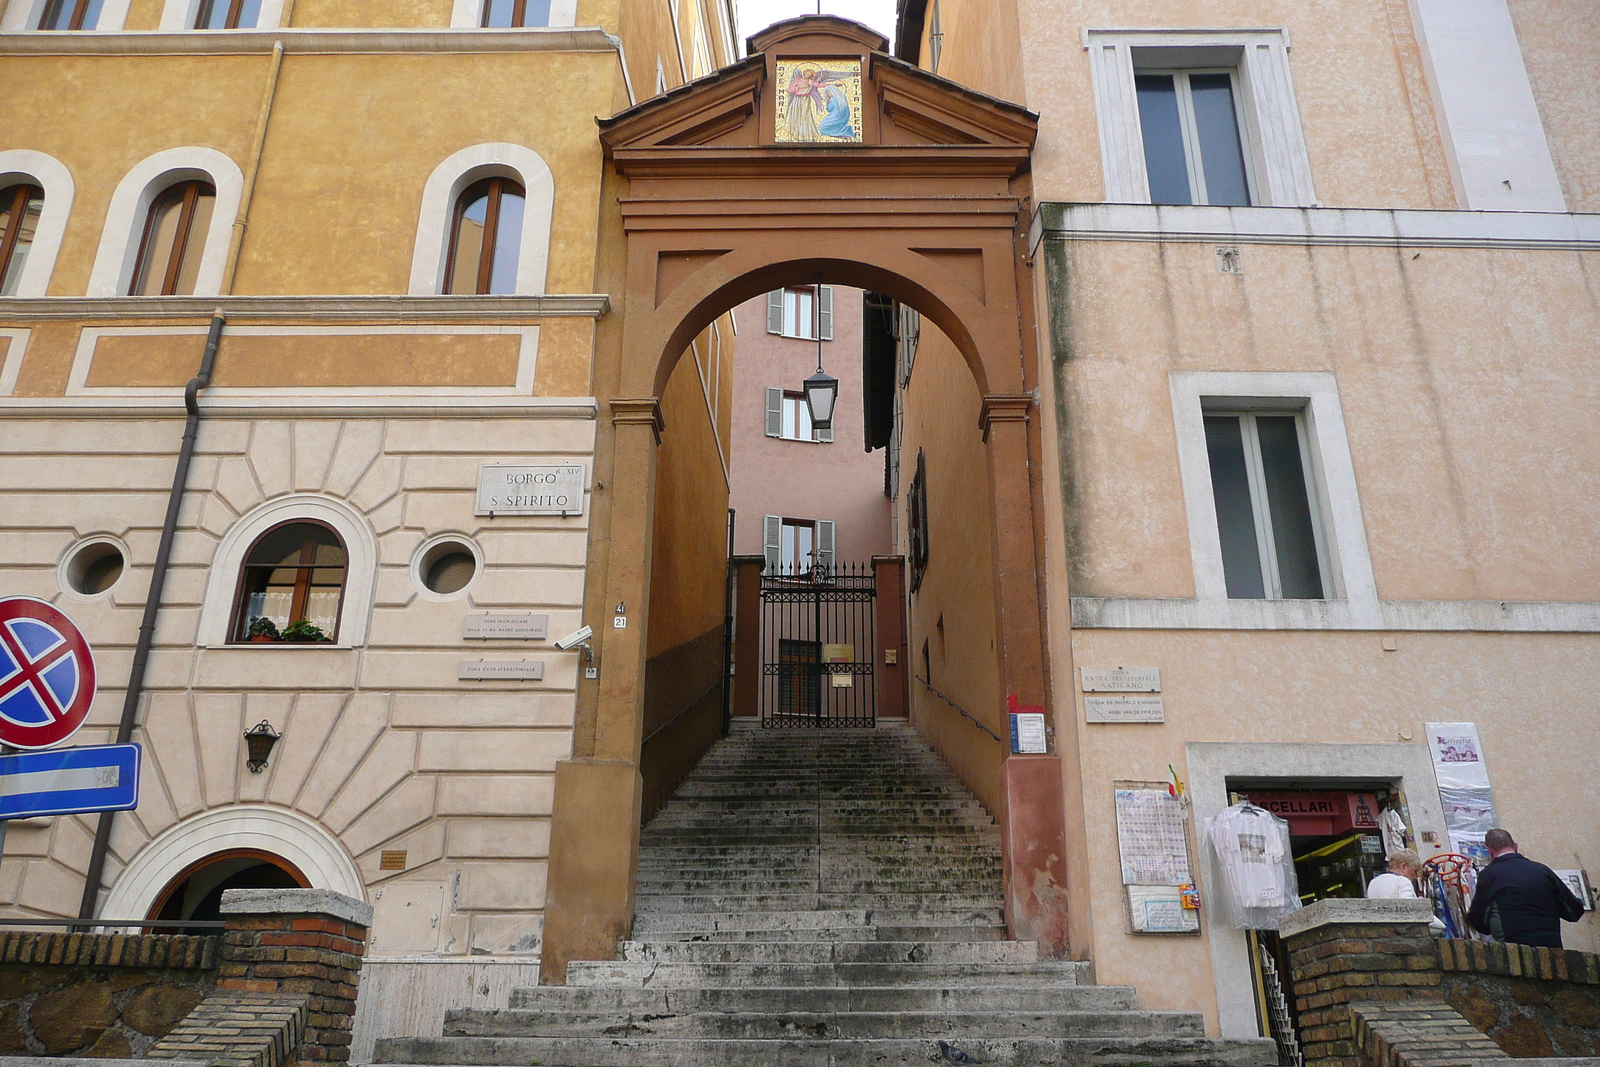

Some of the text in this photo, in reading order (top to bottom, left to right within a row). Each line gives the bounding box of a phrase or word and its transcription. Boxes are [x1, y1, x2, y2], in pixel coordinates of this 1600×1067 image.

[853, 107, 861, 137] PLENA
[506, 473, 556, 485] BORGO
[506, 495, 568, 506] SPIRITO
[615, 618, 625, 627] 21
